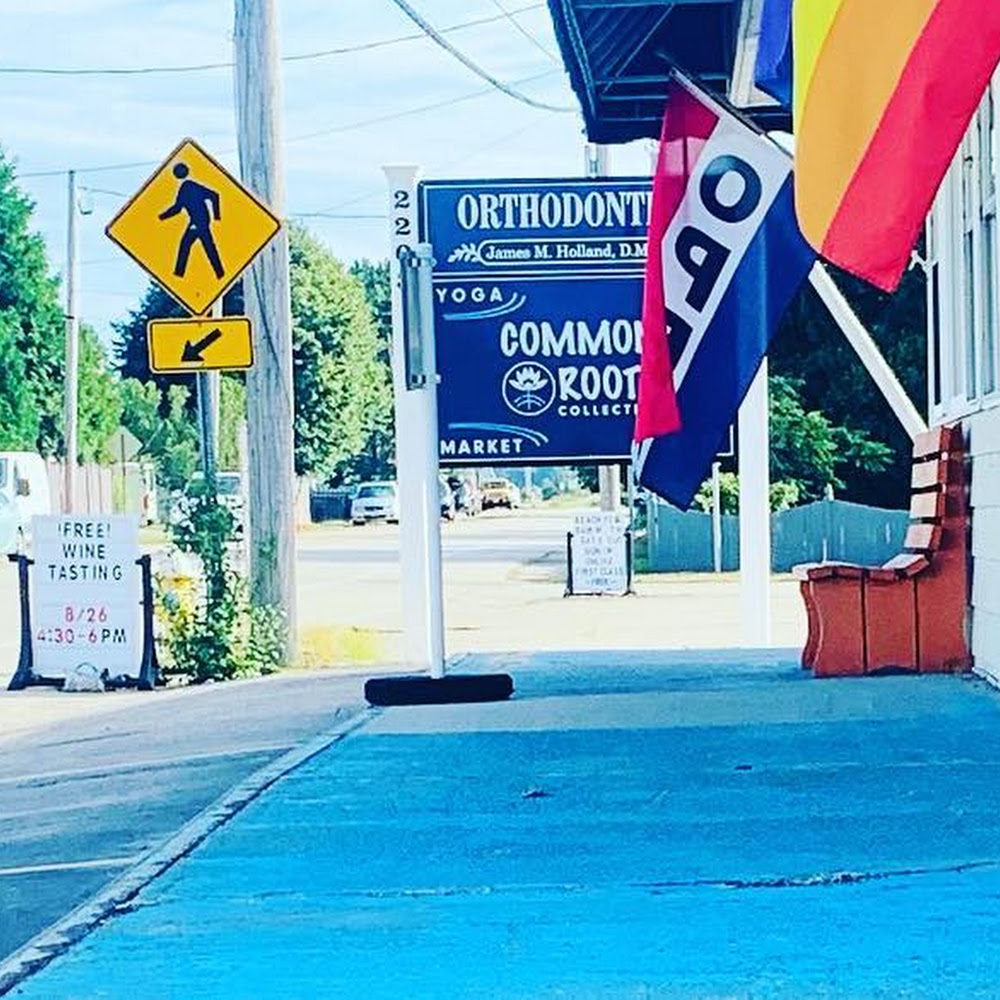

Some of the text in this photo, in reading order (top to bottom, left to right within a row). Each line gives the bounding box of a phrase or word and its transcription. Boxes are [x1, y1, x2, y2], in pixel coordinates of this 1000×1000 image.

[485, 246, 531, 259] James
[534, 245, 552, 258] M.
[556, 243, 616, 259] Holland,
[435, 286, 503, 303] YOGA
[440, 438, 524, 455] MARKET
[62, 543, 105, 559] WINE
[49, 564, 123, 581] TASTING
[65, 606, 107, 622] 8/26
